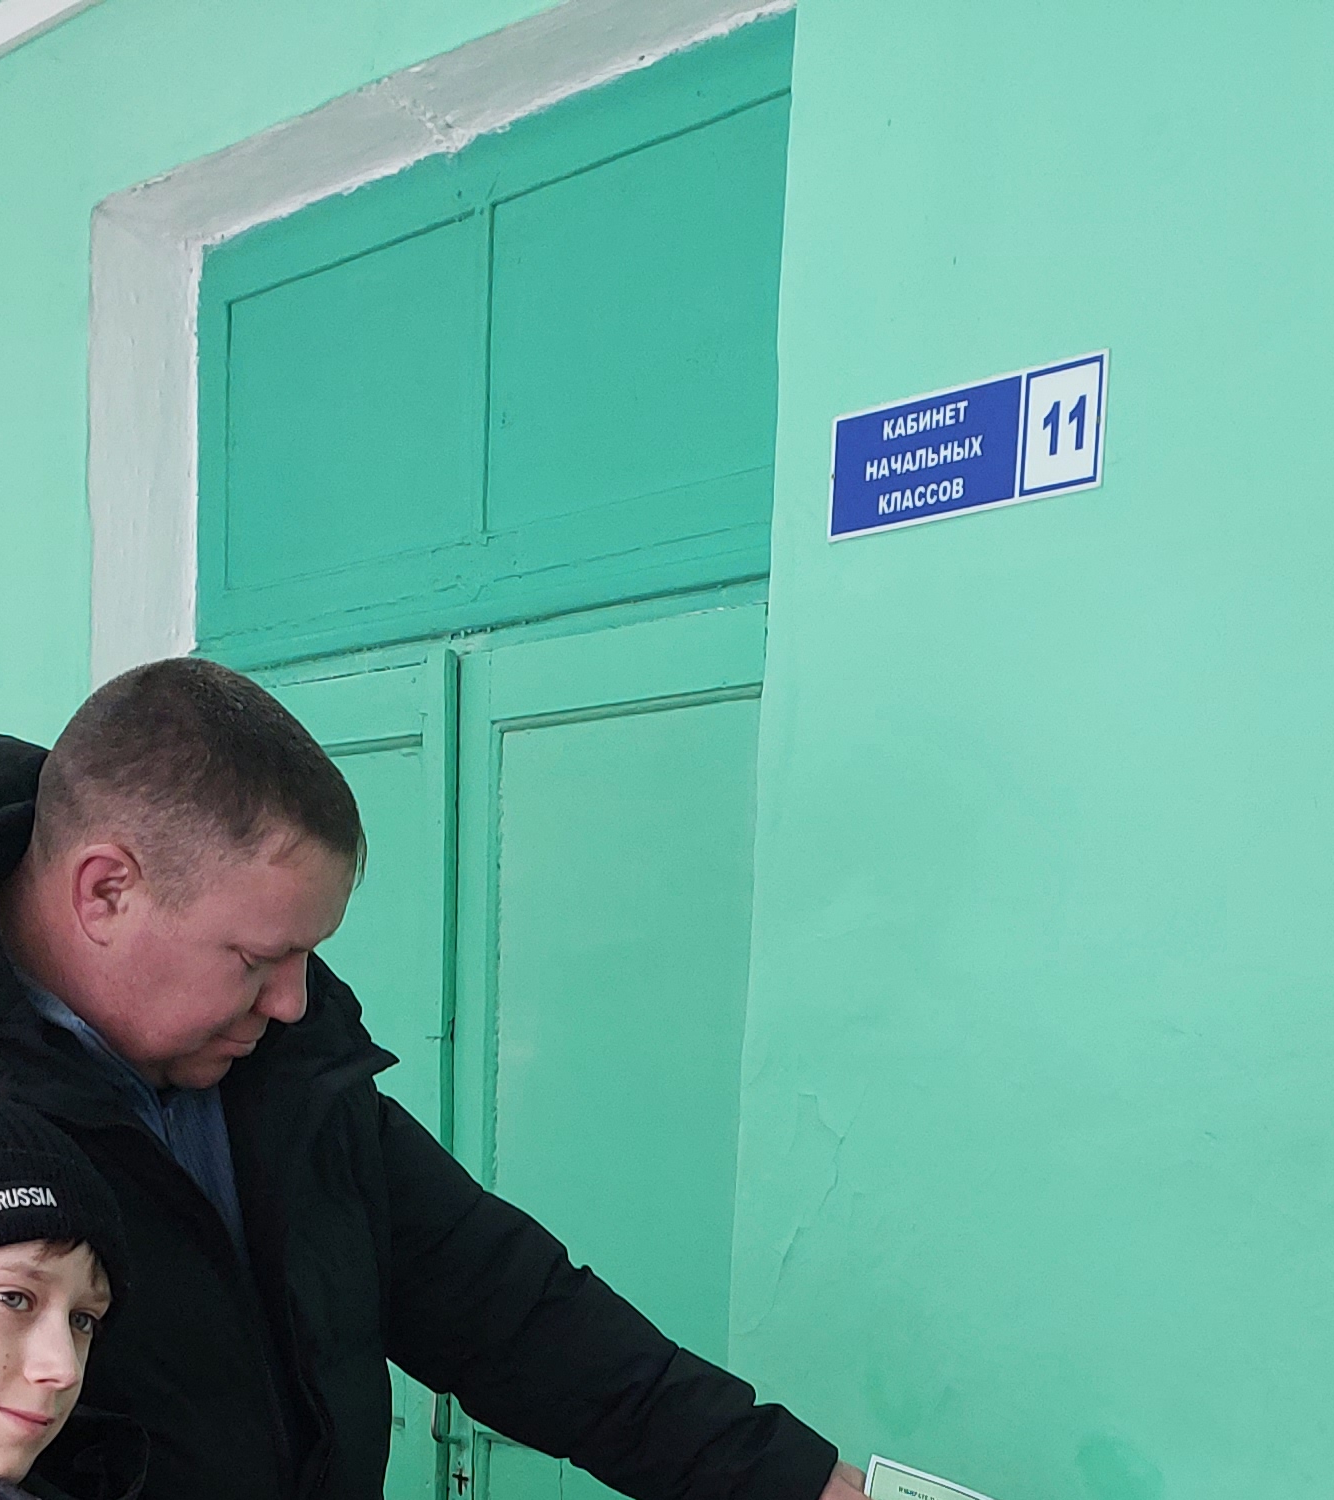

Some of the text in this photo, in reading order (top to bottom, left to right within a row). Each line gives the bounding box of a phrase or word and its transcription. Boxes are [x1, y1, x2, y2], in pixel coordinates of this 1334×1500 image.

[882, 400, 968, 441] КАБИНЕТ
[1043, 394, 1087, 456] 11
[865, 435, 983, 481] НАЧАЛЬНЫХ
[878, 477, 964, 515] КЛАССОВ
